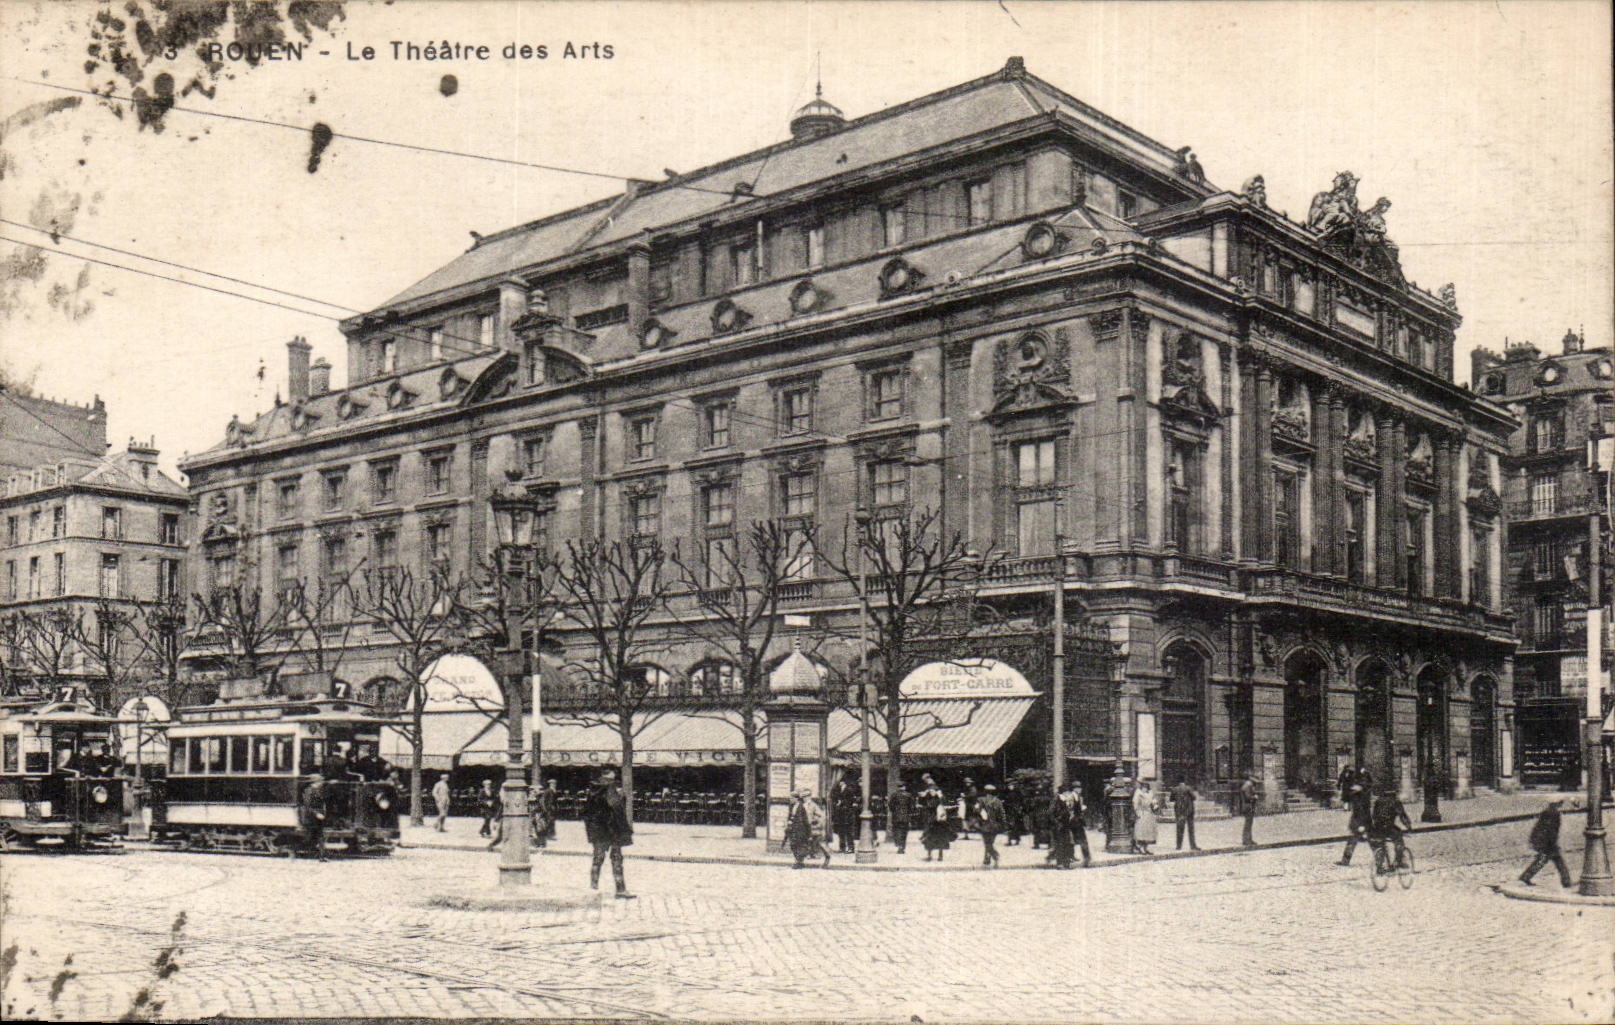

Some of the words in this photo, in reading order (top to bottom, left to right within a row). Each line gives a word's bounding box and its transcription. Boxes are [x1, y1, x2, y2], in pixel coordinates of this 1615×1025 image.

[62, 687, 73, 701] 7
[335, 682, 346, 698] 7
[489, 751, 571, 763] GND
